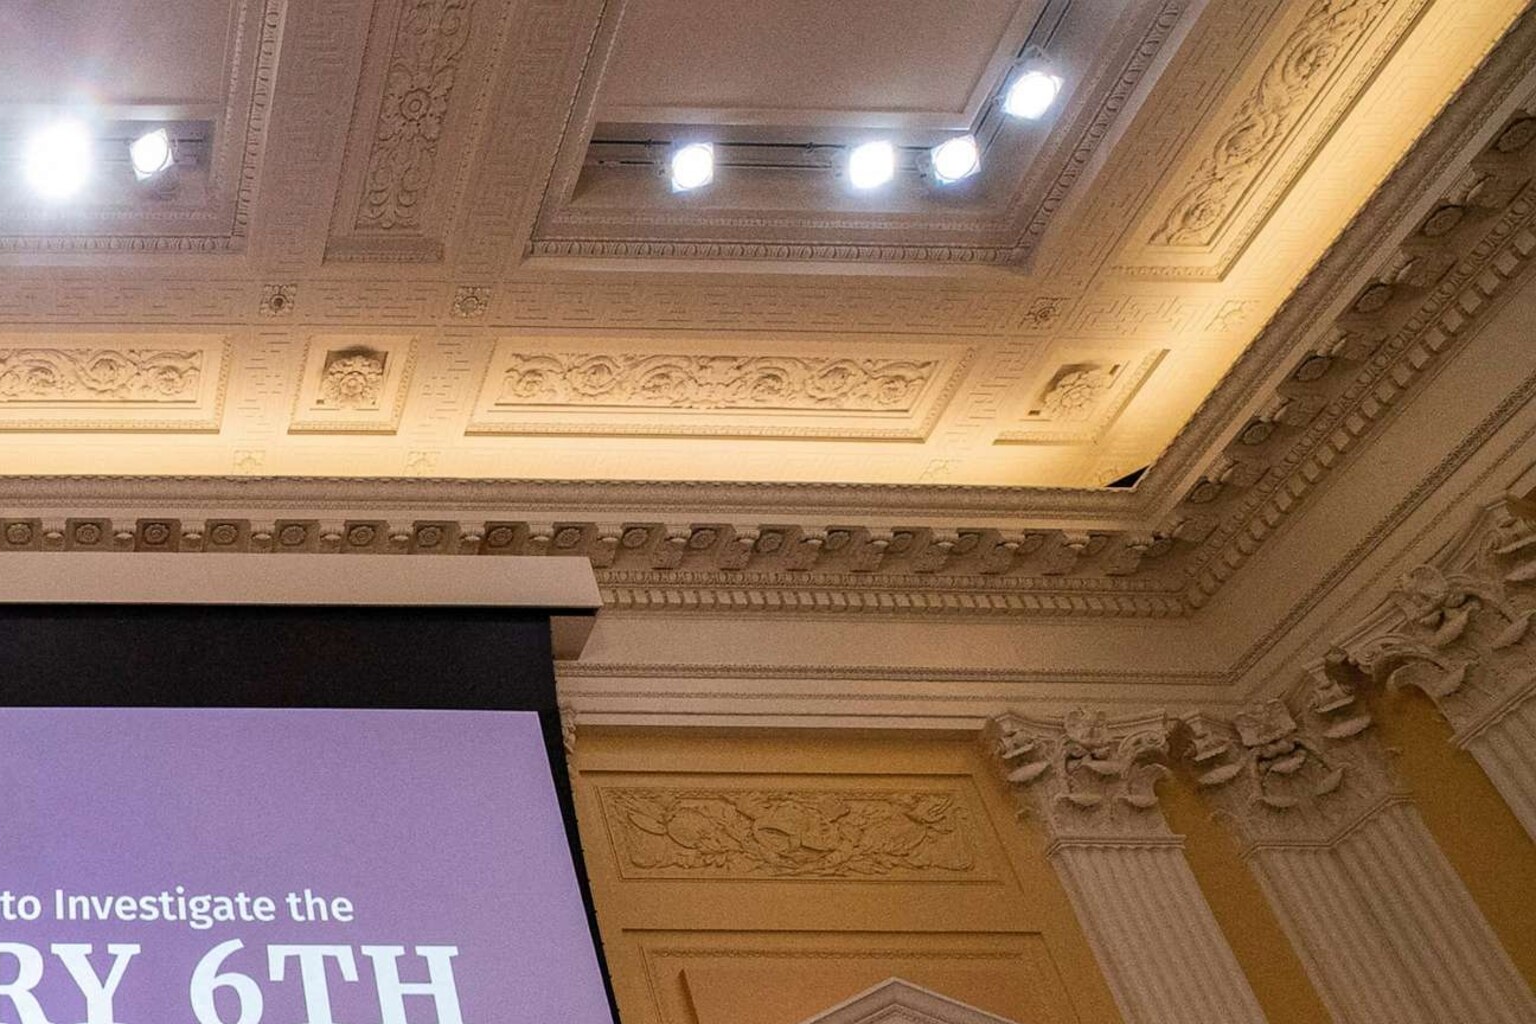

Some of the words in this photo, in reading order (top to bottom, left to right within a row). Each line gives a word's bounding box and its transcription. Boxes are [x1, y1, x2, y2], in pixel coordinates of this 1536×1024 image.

[0, 891, 41, 920] to
[55, 886, 276, 930] Investigate
[285, 889, 353, 922] the
